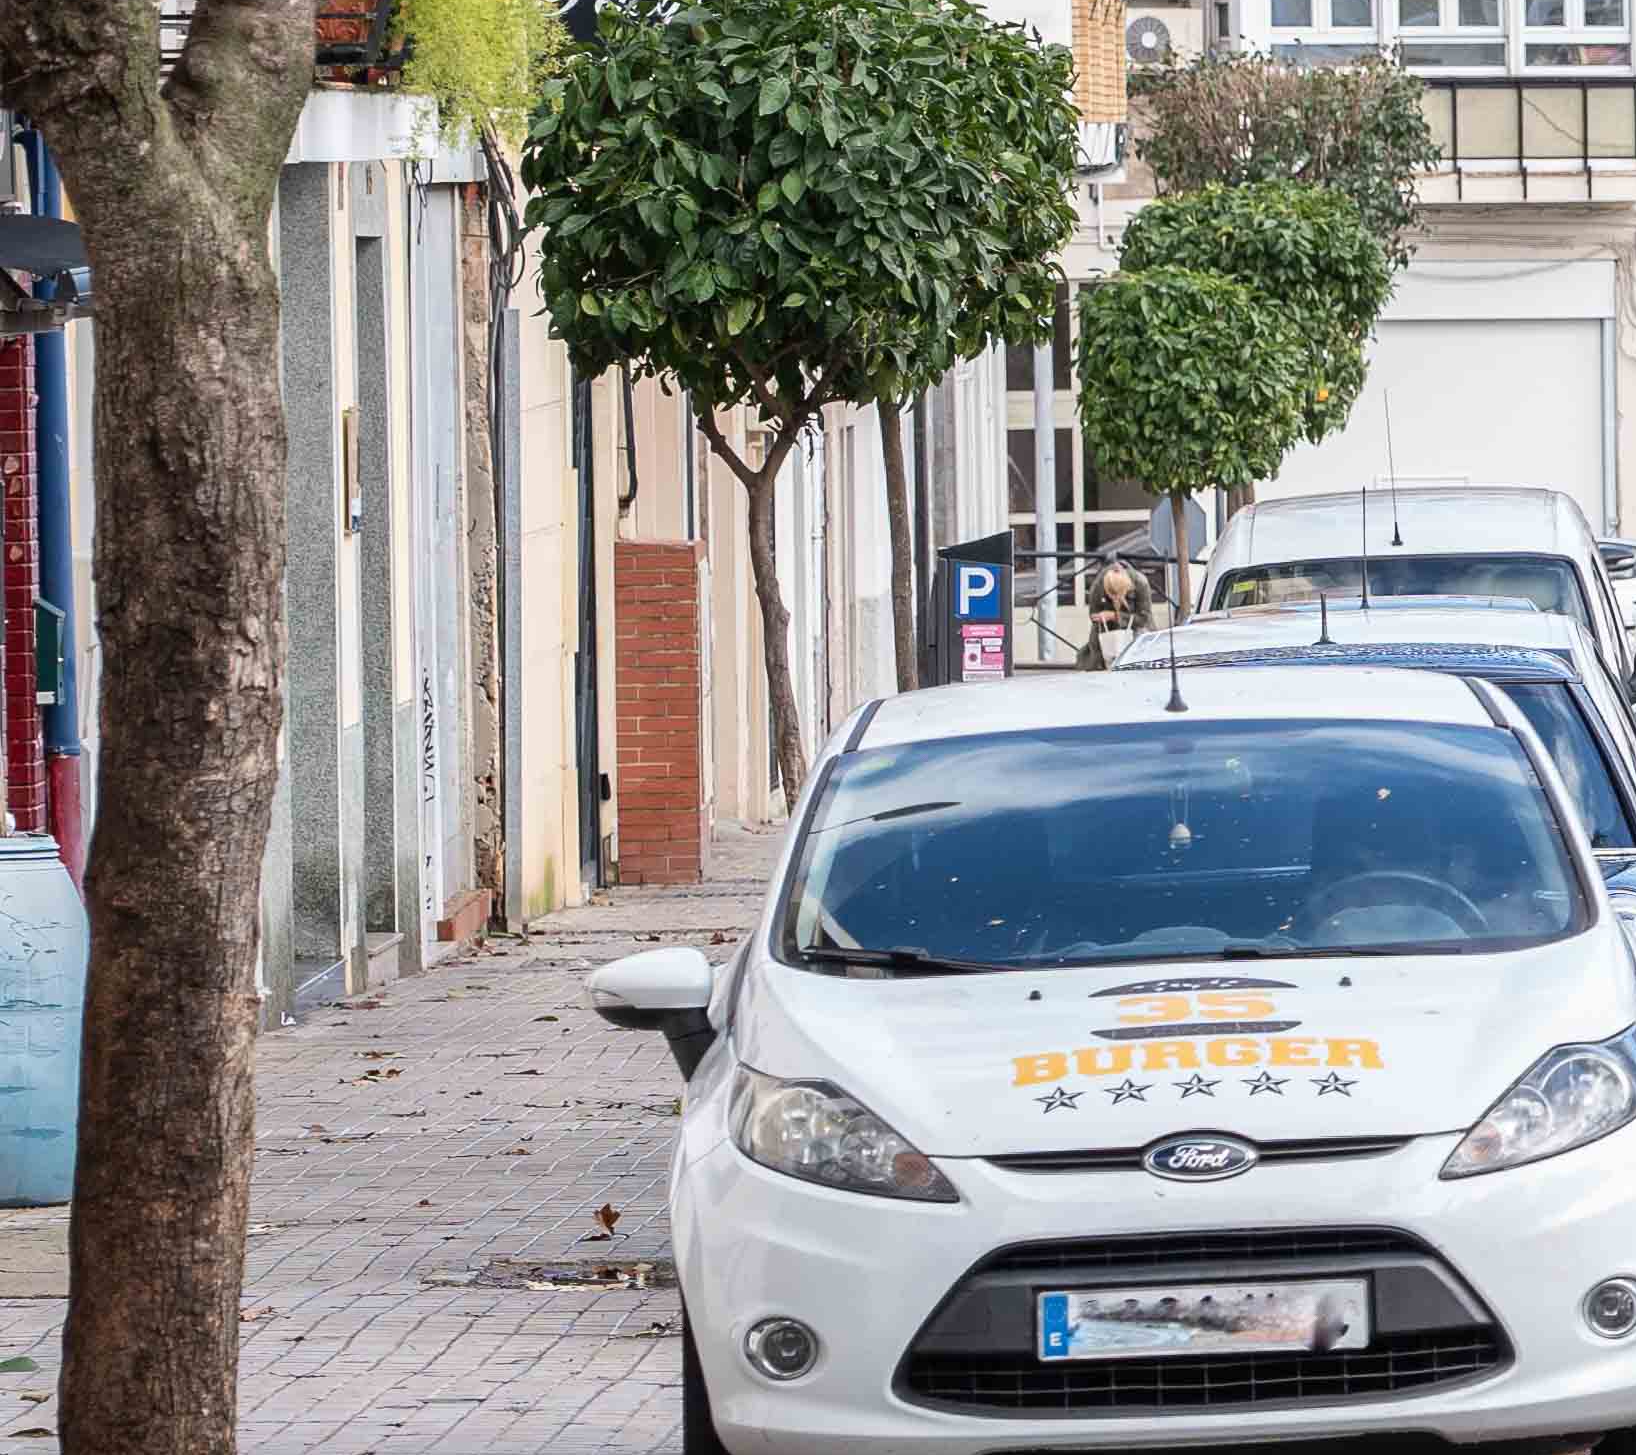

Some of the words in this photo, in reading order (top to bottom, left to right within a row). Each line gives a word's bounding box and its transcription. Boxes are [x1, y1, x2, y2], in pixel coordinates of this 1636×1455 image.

[959, 566, 995, 615] P
[1117, 991, 1276, 1024] 35
[1012, 1037, 1384, 1087] BURGER
[1167, 1145, 1229, 1170] Ford
[1049, 1331, 1063, 1347] E
